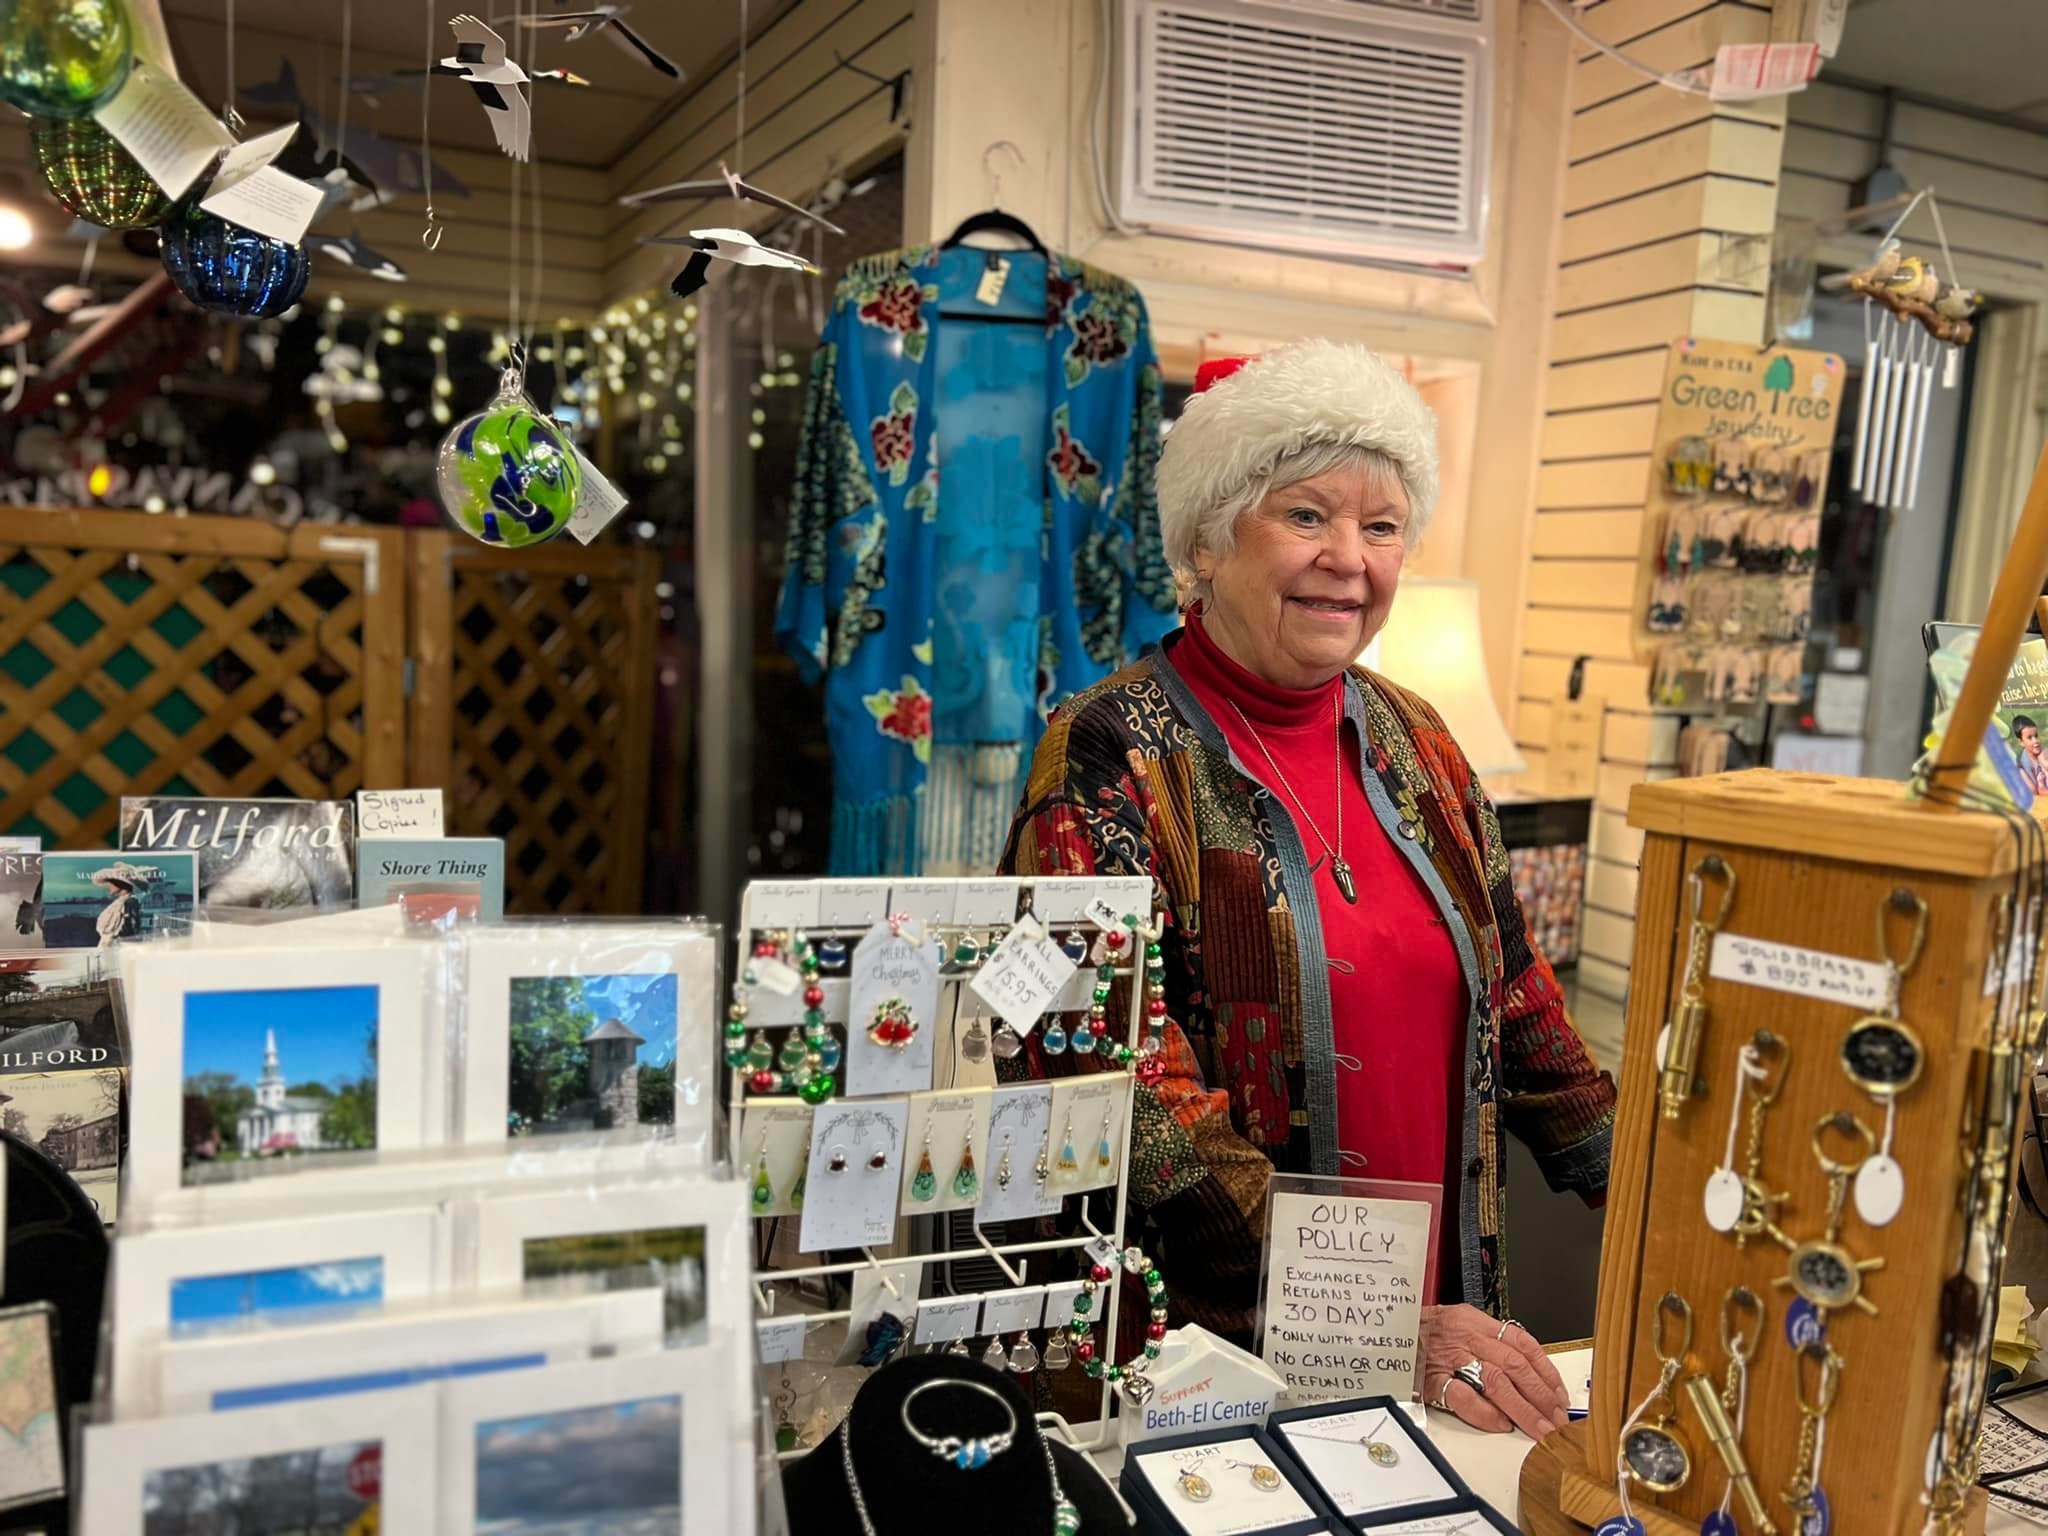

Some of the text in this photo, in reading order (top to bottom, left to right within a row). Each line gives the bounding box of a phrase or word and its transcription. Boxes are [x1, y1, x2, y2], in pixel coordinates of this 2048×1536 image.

[1671, 374, 1757, 412] Green
[363, 792, 425, 811] Signed
[126, 805, 345, 860] Milford
[380, 860, 488, 878] Shore Thing
[1009, 939, 1058, 995] EARRINGS
[1311, 1203, 1369, 1226] OUR
[1297, 1226, 1395, 1253] POLICY
[1286, 1266, 1411, 1288] EXCHANGES OR
[1282, 1283, 1417, 1305] RETURNS WITHIN
[1284, 1303, 1317, 1322] 30
[1318, 1335, 1354, 1346] WITH
[1358, 1335, 1393, 1348] SALES
[1274, 1351, 1412, 1372] NO CASH OR CARD
[1286, 1373, 1365, 1390] REFUNDS
[1146, 1400, 1269, 1430] Beth-El Center
[1308, 1414, 1357, 1429] CHART
[1172, 1446, 1222, 1461] CHART
